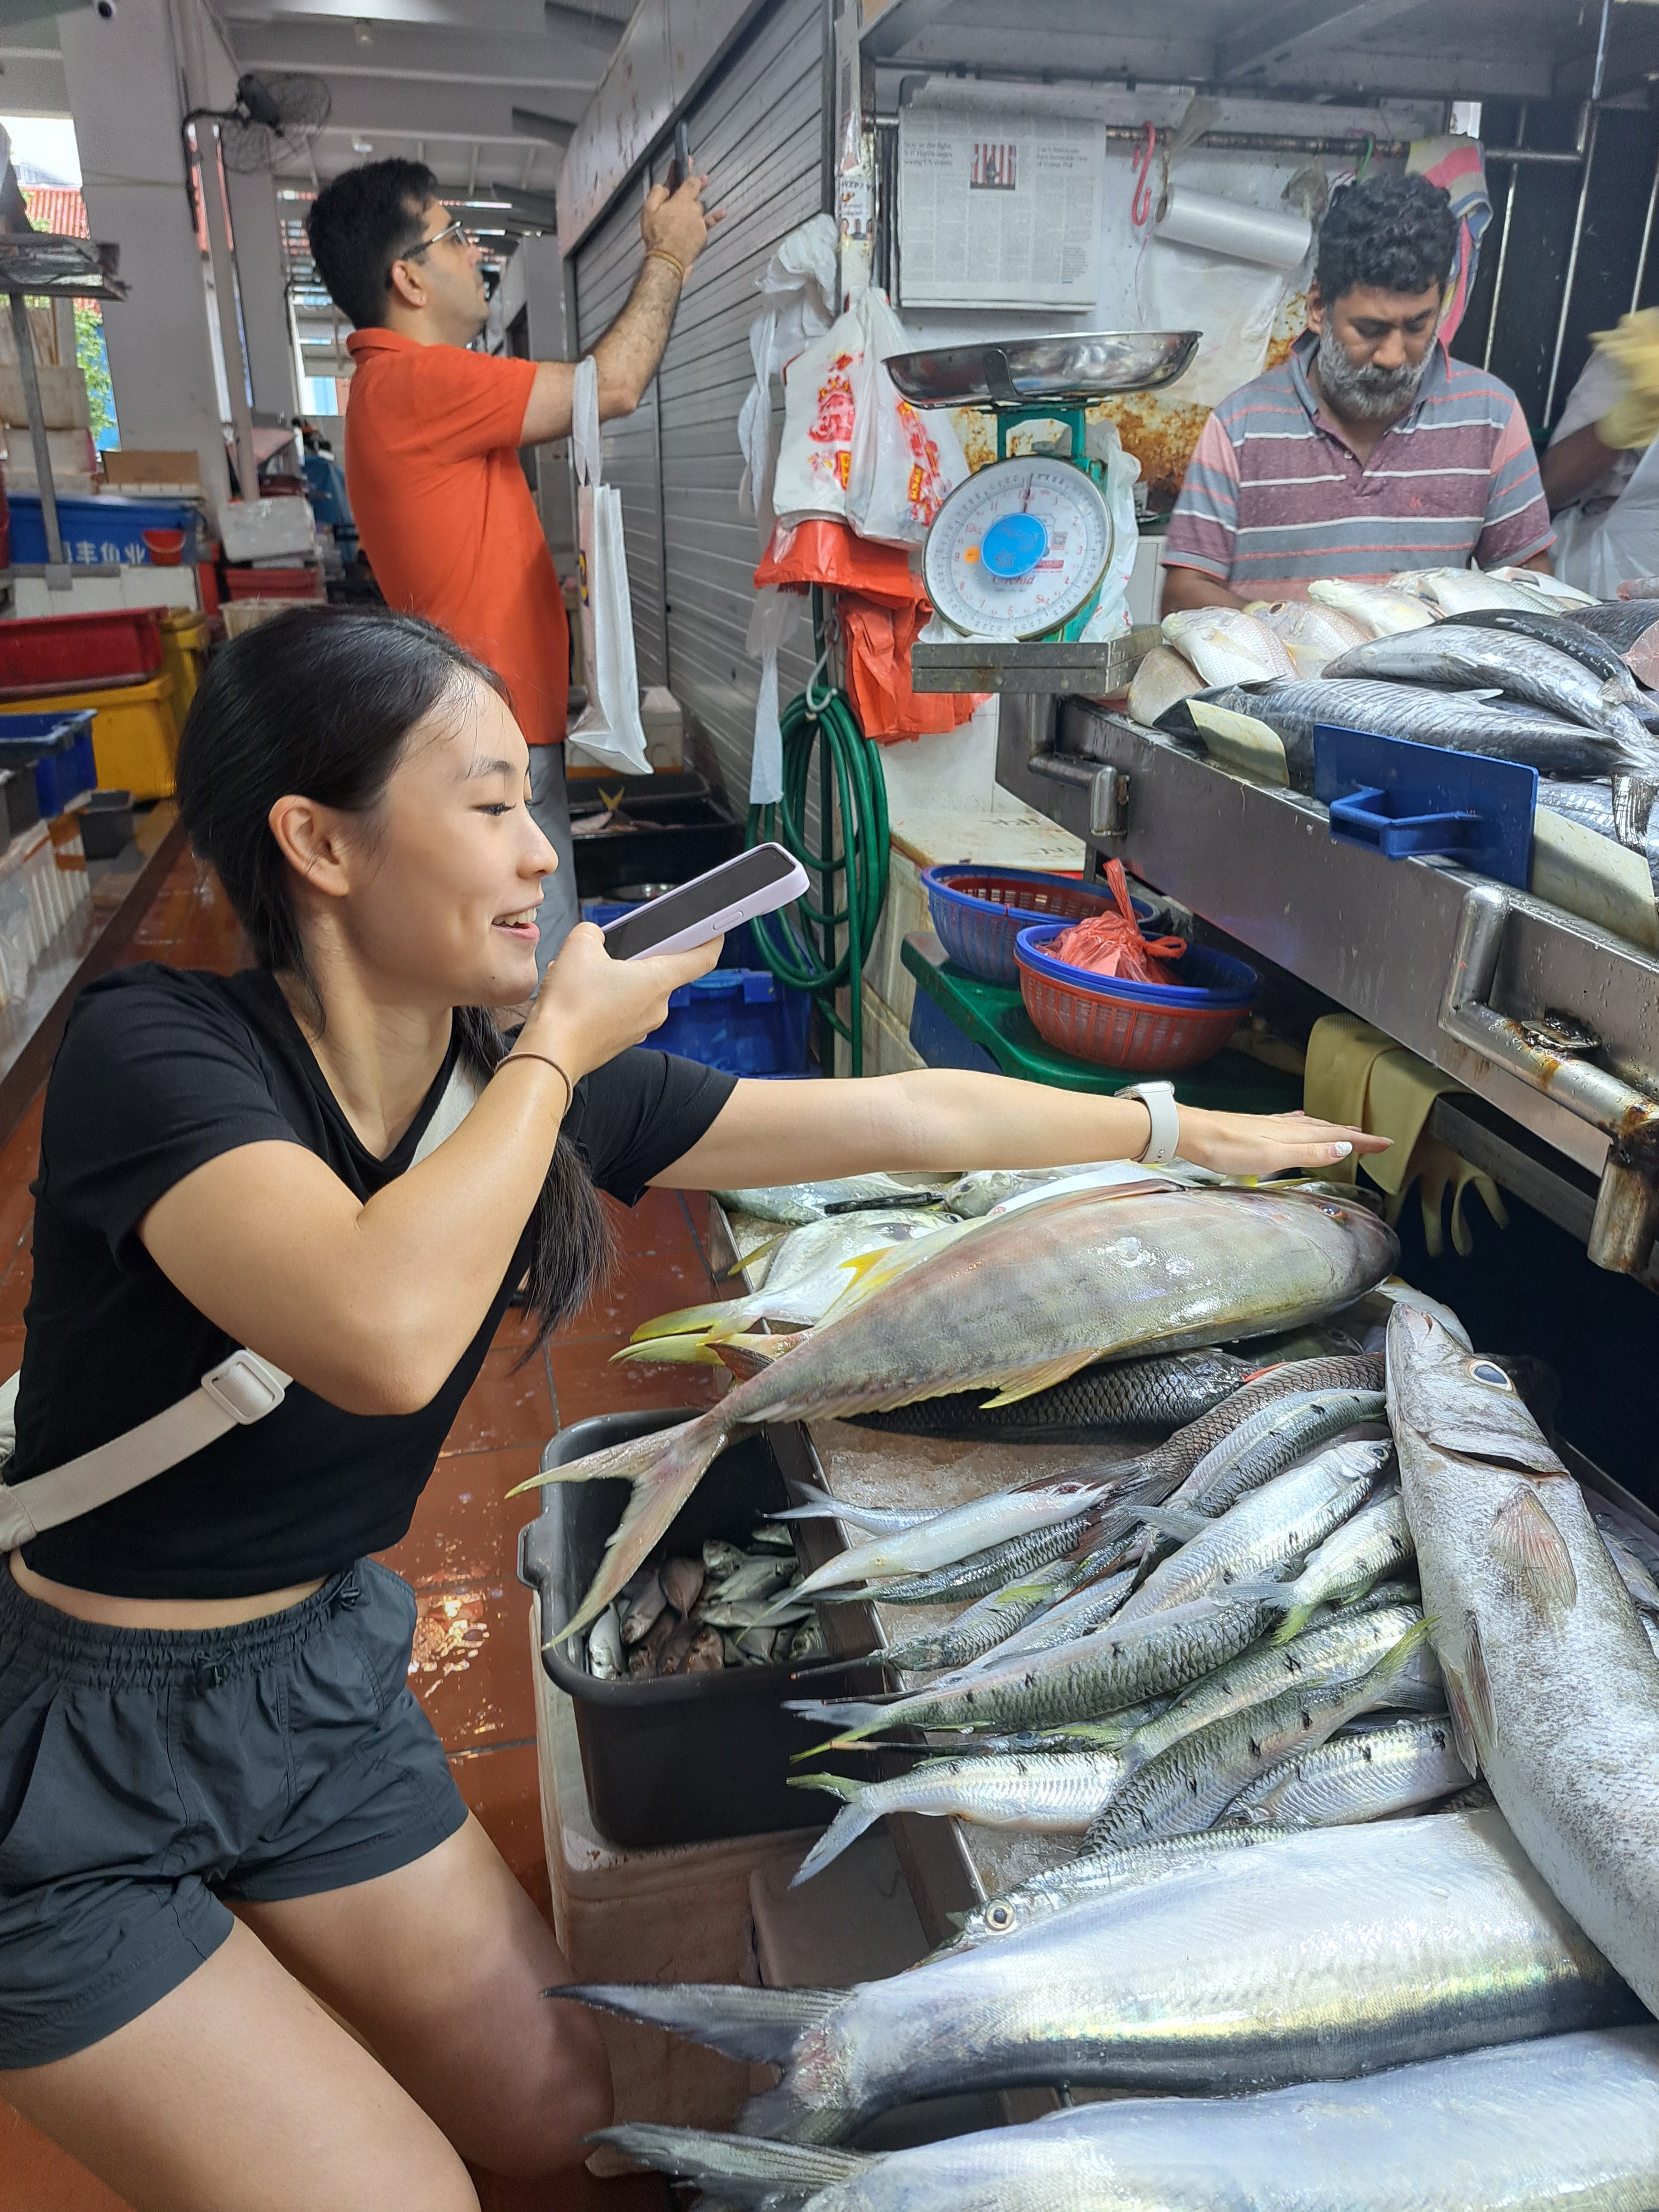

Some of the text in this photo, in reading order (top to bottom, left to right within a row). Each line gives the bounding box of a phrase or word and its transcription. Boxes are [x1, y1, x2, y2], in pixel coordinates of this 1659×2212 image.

[1073, 516, 1078, 526] 2
[1035, 594, 1050, 606] 5kg
[1007, 605, 1014, 616] 6
